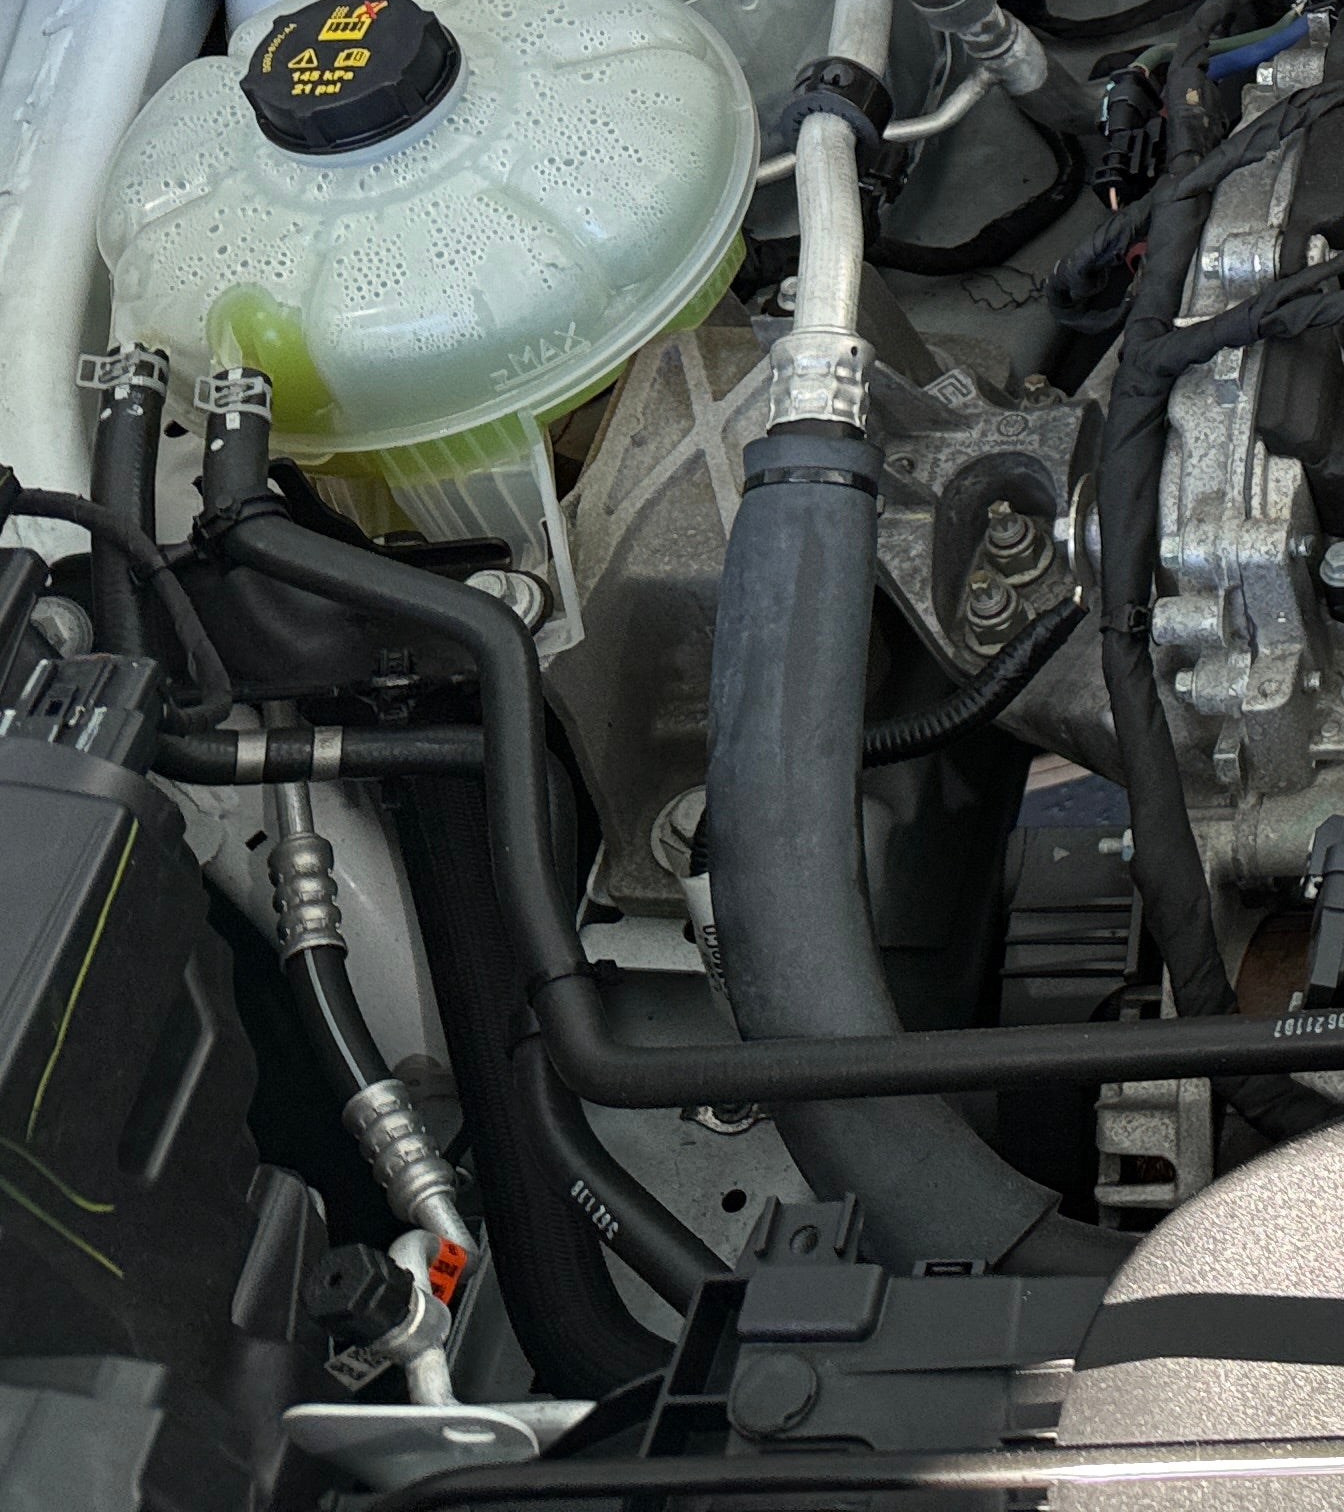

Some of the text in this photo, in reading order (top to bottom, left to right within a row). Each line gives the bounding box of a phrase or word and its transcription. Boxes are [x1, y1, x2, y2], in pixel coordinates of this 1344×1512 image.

[291, 70, 354, 82] 145 kPa
[291, 82, 342, 96] 21 psi
[508, 322, 588, 377] MAX
